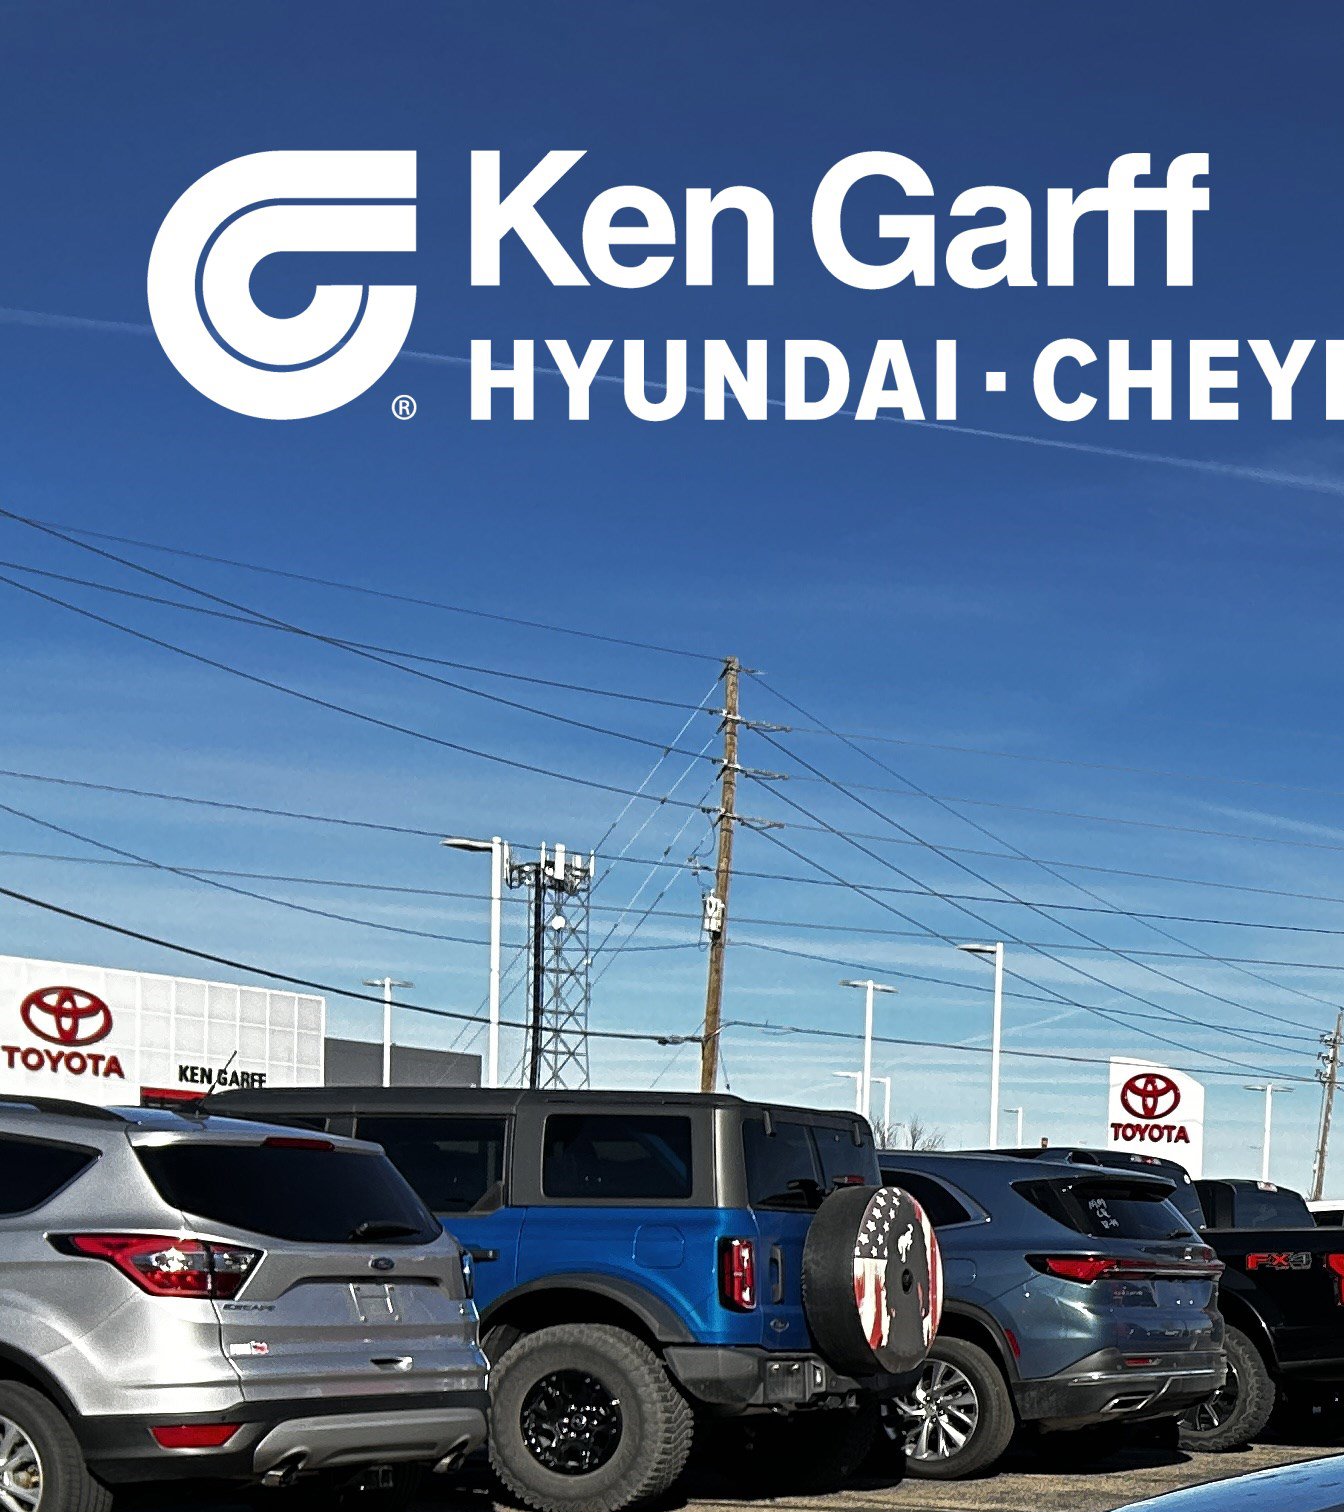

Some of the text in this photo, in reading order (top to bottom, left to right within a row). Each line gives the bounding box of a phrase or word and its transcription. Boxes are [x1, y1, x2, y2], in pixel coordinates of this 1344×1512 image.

[1, 1045, 126, 1079] TOYOTA
[179, 1064, 267, 1088] KEN GARFF
[1110, 1122, 1190, 1143] TOYOTA
